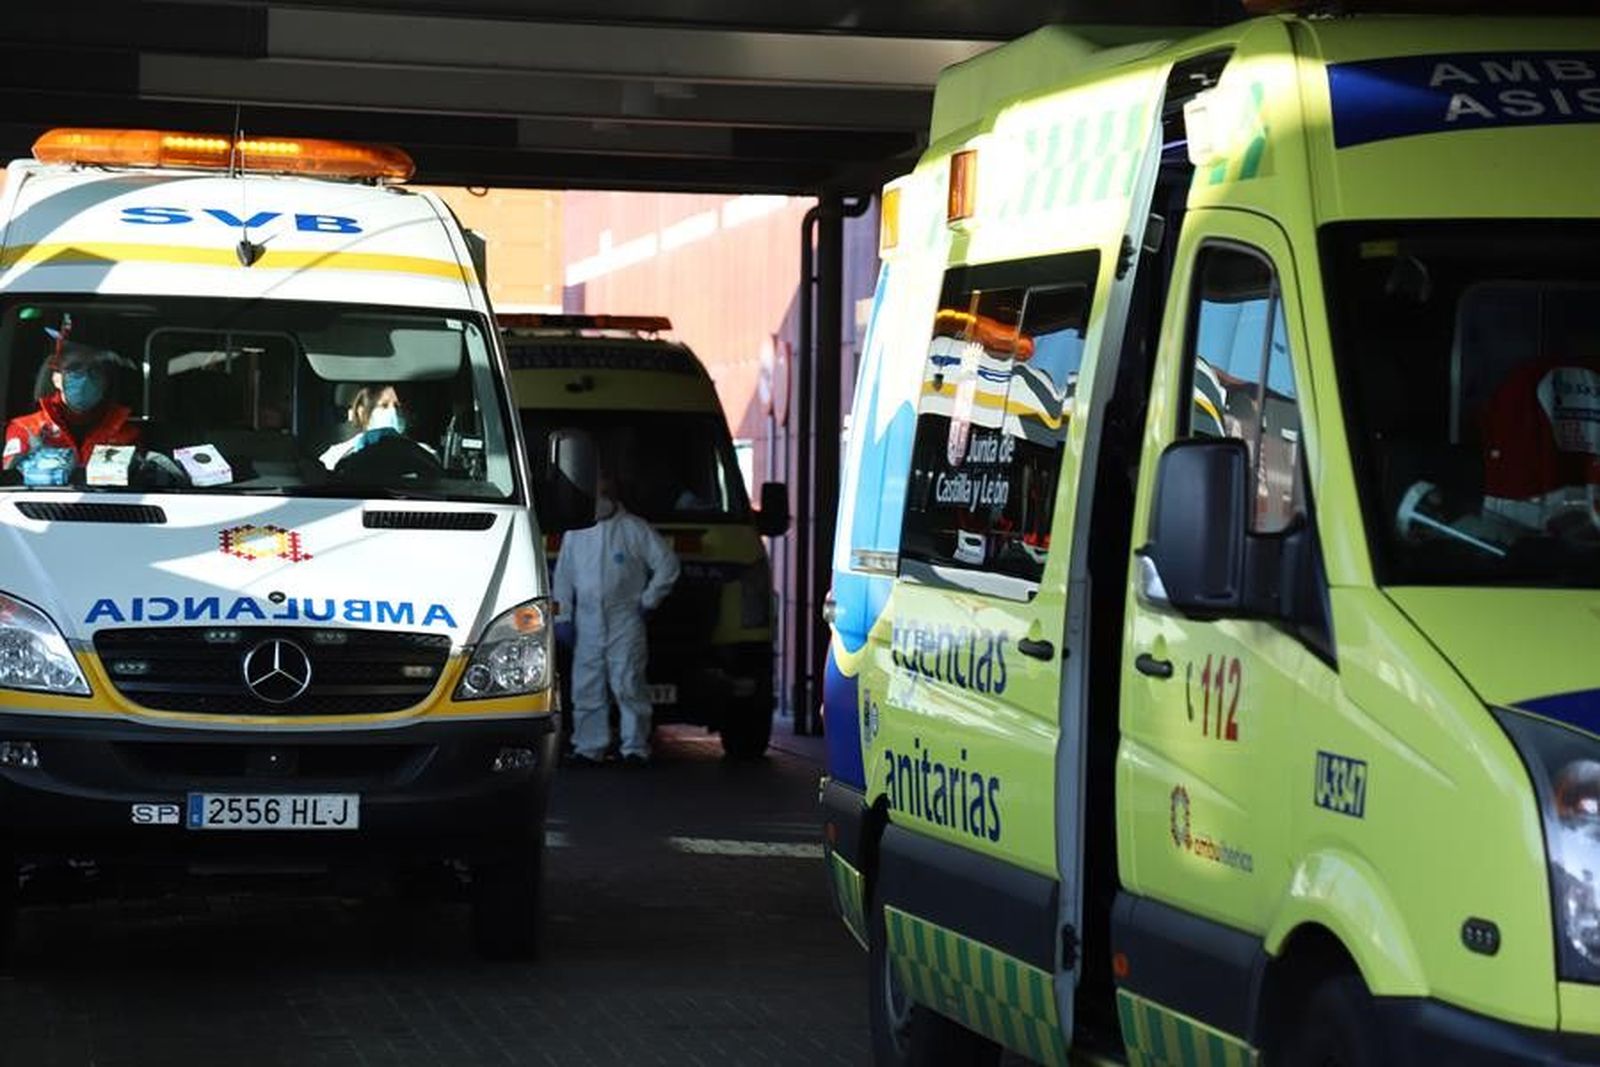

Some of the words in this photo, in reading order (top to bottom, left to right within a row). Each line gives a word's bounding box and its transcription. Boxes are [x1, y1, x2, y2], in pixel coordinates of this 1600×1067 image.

[1429, 59, 1597, 87] AMB
[120, 206, 364, 235] SVB
[966, 433, 998, 463] Junta
[999, 433, 1015, 463] de
[936, 472, 971, 502] Castilla
[970, 479, 981, 512] y
[980, 473, 1009, 505] León
[1201, 654, 1242, 741] 112
[134, 806, 178, 823] SP
[208, 797, 280, 825] 2556
[291, 798, 349, 826] HLJ
